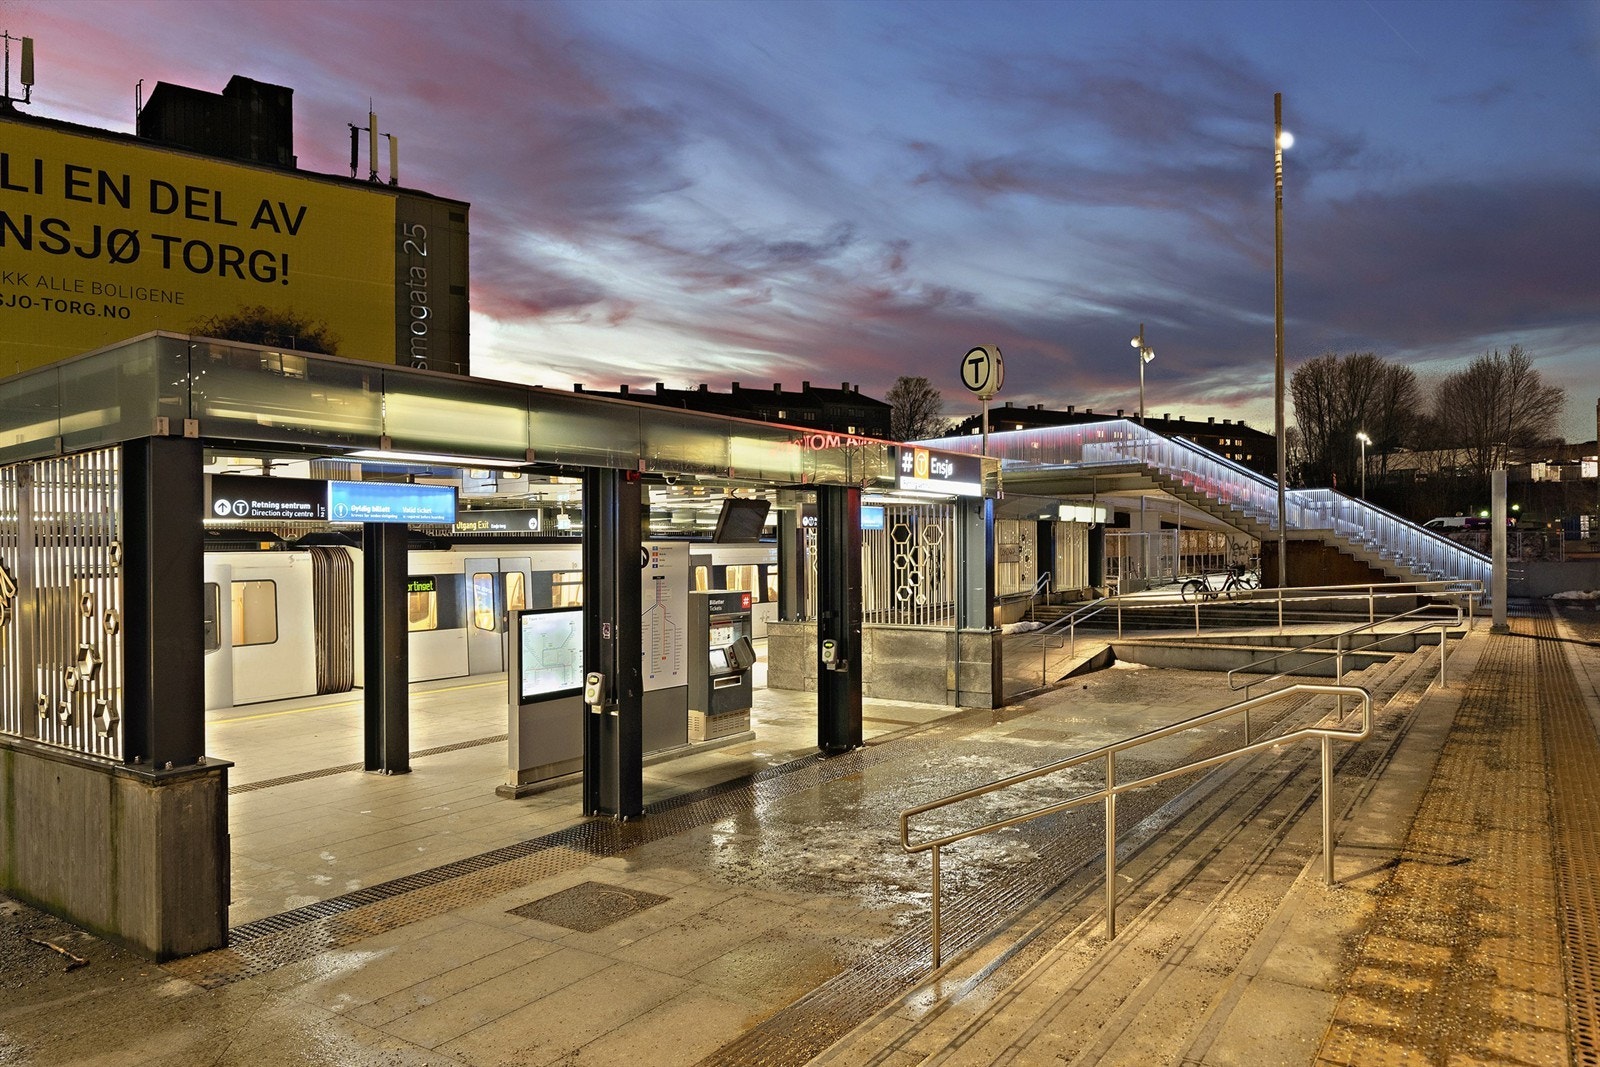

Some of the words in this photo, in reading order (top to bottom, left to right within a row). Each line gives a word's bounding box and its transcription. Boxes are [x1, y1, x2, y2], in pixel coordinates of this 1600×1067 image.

[65, 163, 130, 209] EN
[150, 179, 238, 227] DEL
[250, 199, 308, 236] AV
[0, 210, 141, 264] NSJØ
[151, 233, 289, 285] TORG!
[403, 223, 428, 257] 25
[36, 275, 84, 294] ALLE
[92, 281, 185, 306] BOLIGENE
[931, 457, 953, 479] Ensjø
[252, 501, 279, 510] Retning
[281, 502, 311, 510] sentrum
[252, 509, 281, 517] Direction
[281, 510, 293, 518] city
[478, 520, 489, 529] Exit
